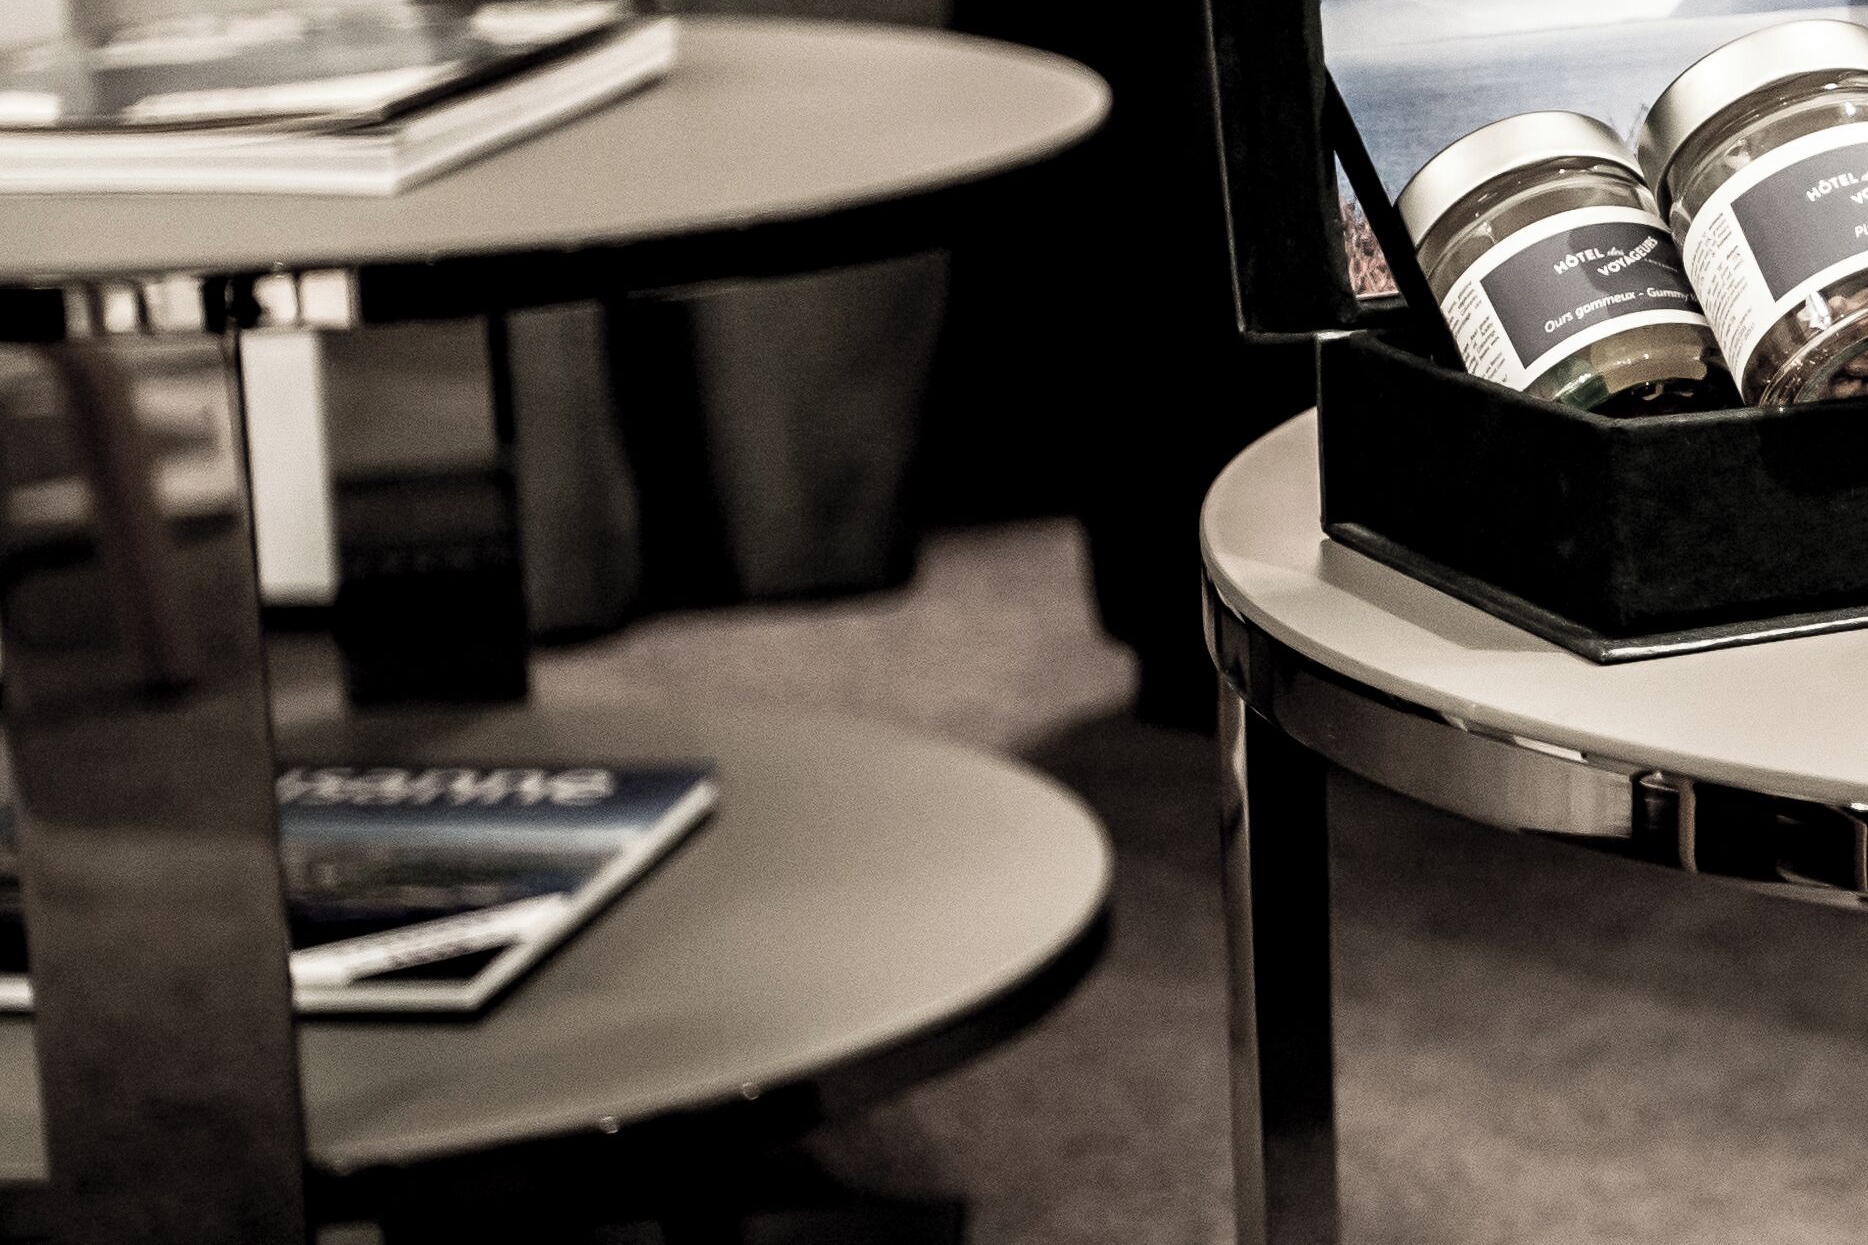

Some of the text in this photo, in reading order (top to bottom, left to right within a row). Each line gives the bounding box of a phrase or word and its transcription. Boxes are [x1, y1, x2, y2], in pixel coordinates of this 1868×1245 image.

[1806, 172, 1859, 202] HÔTEL
[1553, 247, 1605, 275] HÔTEL
[1597, 235, 1659, 277] VOYAGEURS
[1543, 310, 1574, 334] Ours
[1574, 290, 1637, 320] gommeux
[1646, 287, 1689, 304] Gummy
